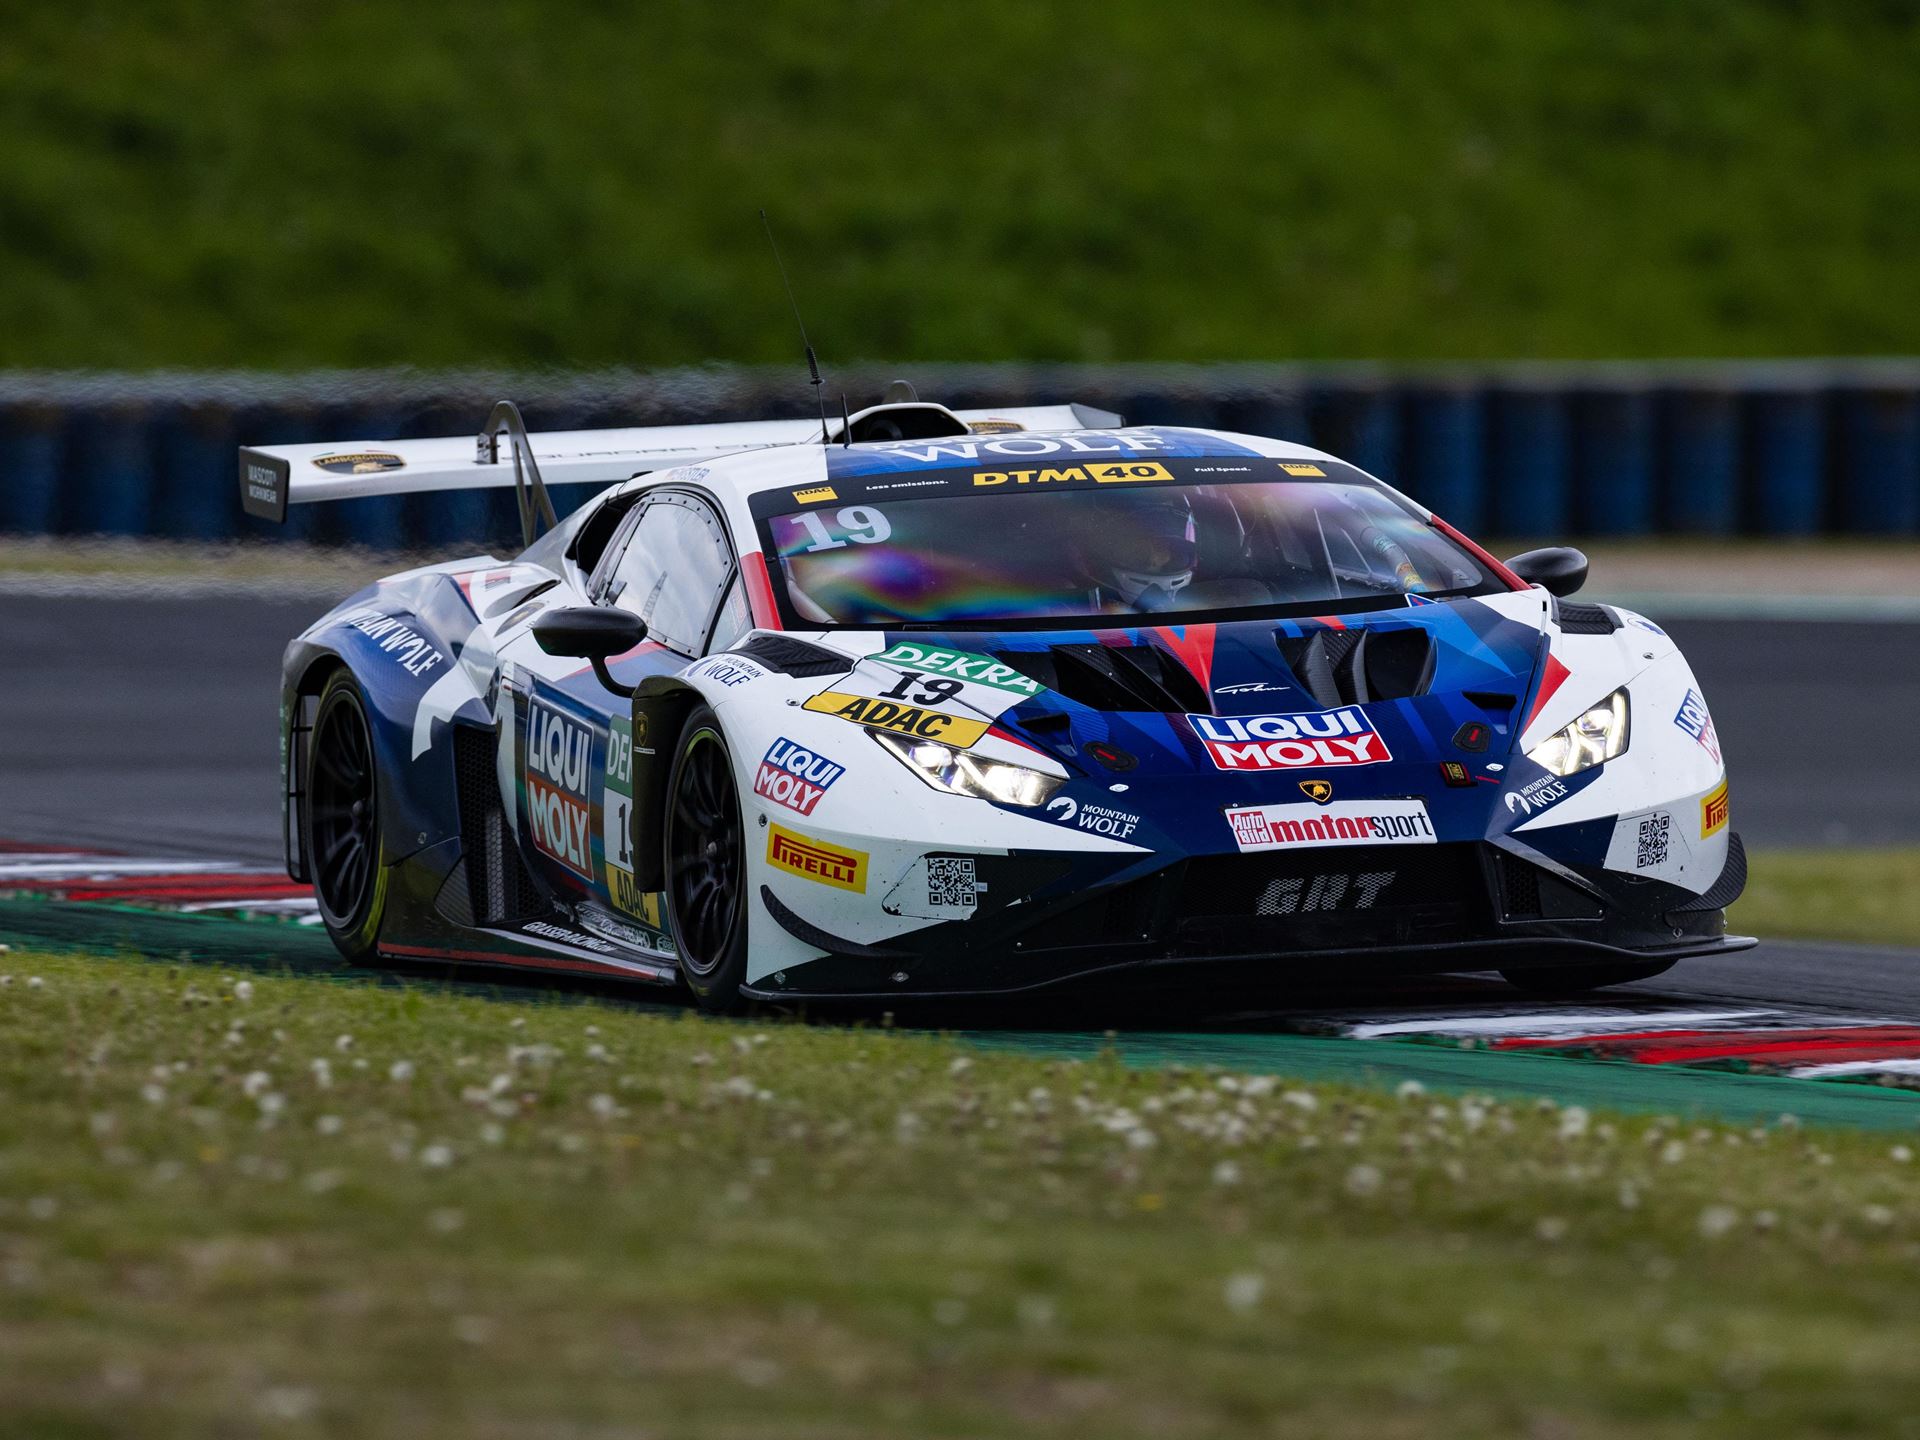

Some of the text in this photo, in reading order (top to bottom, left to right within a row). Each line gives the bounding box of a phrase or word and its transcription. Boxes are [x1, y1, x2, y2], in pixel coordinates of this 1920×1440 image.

[878, 434, 1165, 462] WOLF
[796, 487, 831, 497] ADAC
[891, 480, 949, 488] emissions.
[973, 466, 1158, 486] DTM 40
[790, 506, 892, 552] 19
[703, 662, 751, 687] WOLF
[878, 645, 1039, 693] DEKRA
[877, 671, 964, 706] 19
[834, 698, 952, 737] ADAC
[1196, 709, 1364, 742] LIQUI
[528, 705, 590, 797] LIQUI
[766, 740, 841, 787] LIQUI
[1214, 733, 1375, 767] MOLY
[756, 765, 823, 811] MOLY
[1520, 774, 1556, 796] MOUNTAIN
[1527, 781, 1569, 808] WOLF
[1082, 804, 1140, 824] MOUNTAIN
[1705, 785, 1728, 830] PIRE
[529, 780, 588, 870] MOLY
[1078, 812, 1136, 838] WOLF
[772, 833, 858, 883] PIRELLI
[1256, 871, 1397, 916] GRT
